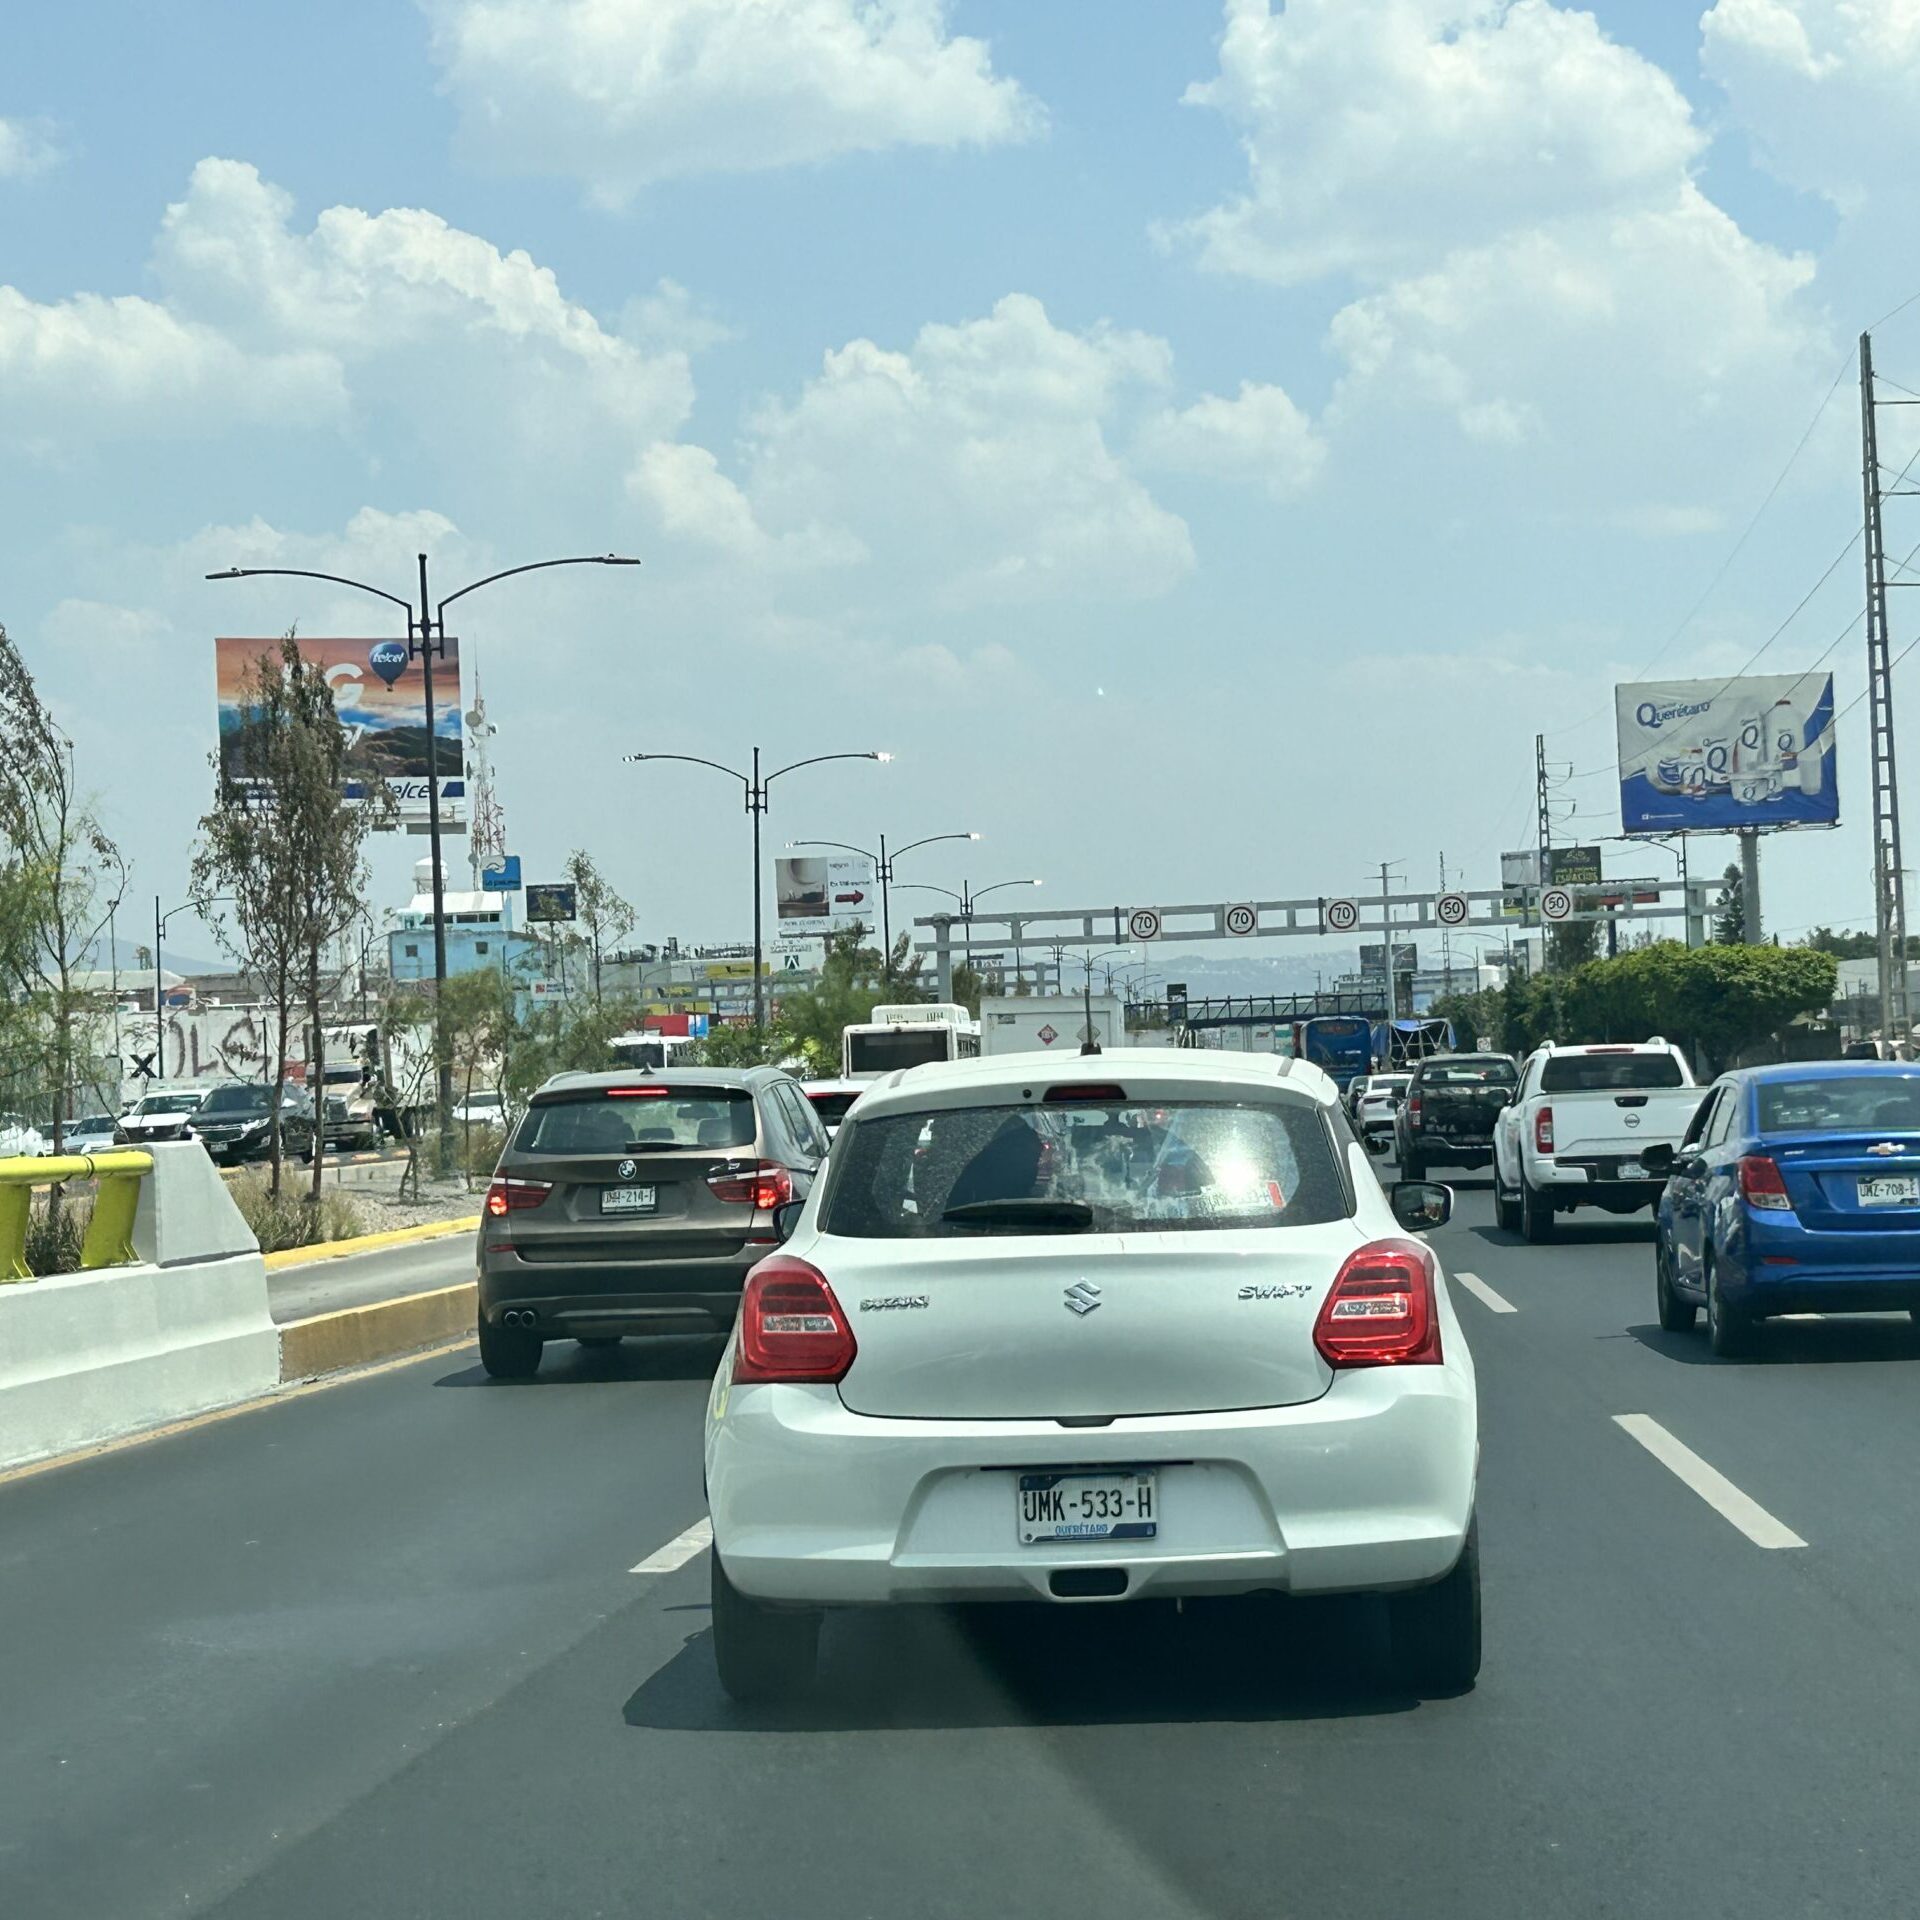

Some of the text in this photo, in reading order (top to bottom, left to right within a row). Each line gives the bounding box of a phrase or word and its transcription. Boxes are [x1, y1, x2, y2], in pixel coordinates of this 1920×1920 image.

[1443, 902, 1461, 915] 50
[1548, 897, 1565, 910] 50
[1233, 912, 1249, 925] 70
[1334, 907, 1351, 920] 70
[1136, 916, 1153, 929] 70
[1023, 1486, 1152, 1523] UMK-533-H
[1055, 1523, 1109, 1537] QUERÉTARO
